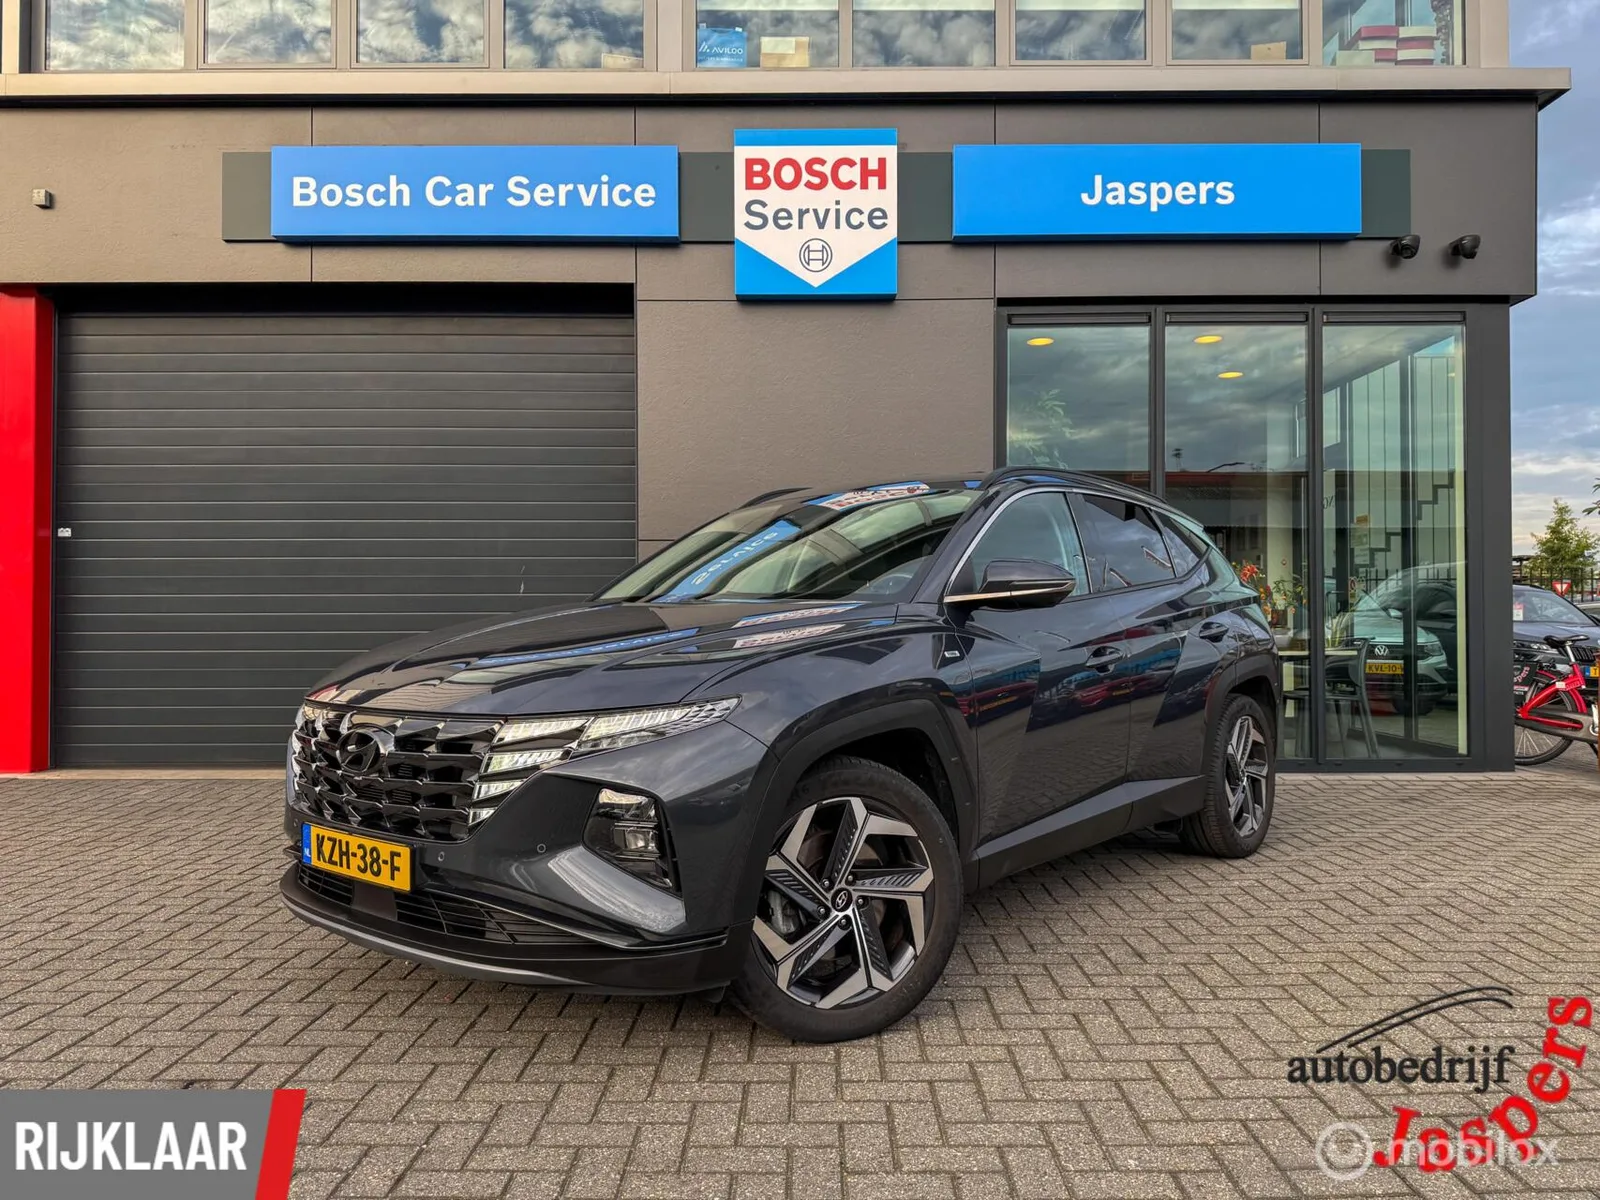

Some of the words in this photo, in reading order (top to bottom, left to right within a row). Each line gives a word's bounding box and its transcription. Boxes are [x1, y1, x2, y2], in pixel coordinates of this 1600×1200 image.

[292, 175, 411, 207] Bosch
[425, 175, 494, 207] Car
[506, 175, 656, 207] Service
[744, 157, 887, 191] BOSCH
[1080, 175, 1236, 212] Jaspers
[743, 199, 888, 230] Service
[316, 833, 402, 881] KZH-38-F
